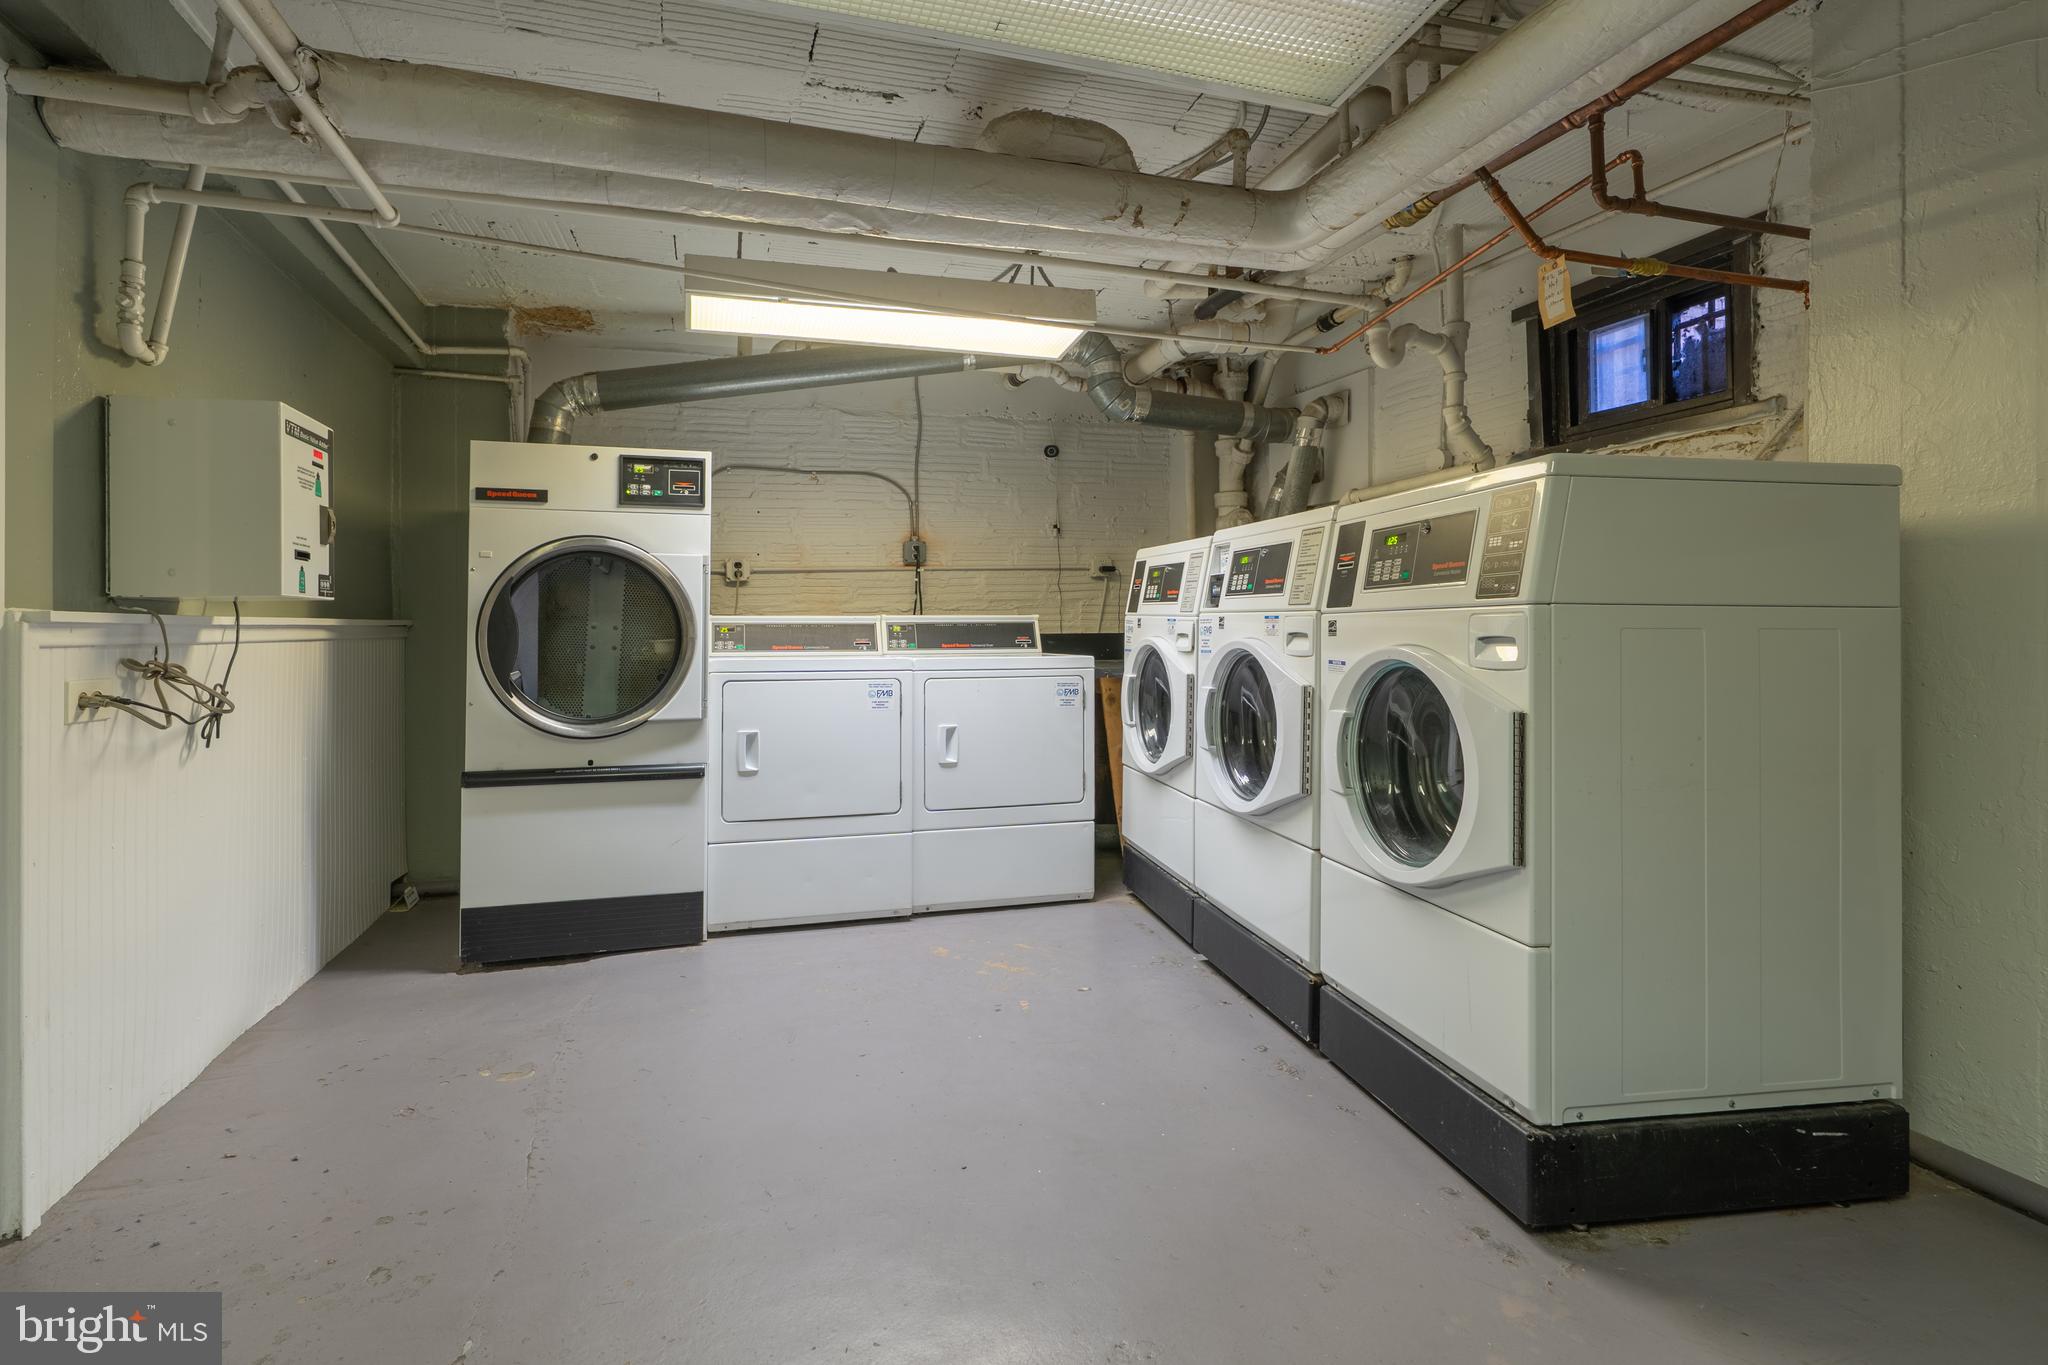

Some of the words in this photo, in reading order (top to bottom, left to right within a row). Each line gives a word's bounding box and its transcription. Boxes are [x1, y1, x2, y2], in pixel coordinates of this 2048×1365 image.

[487, 490, 512, 498] Speed
[512, 491, 537, 499] Queen
[1432, 561, 1449, 571] Speed
[1449, 560, 1466, 569] Queen
